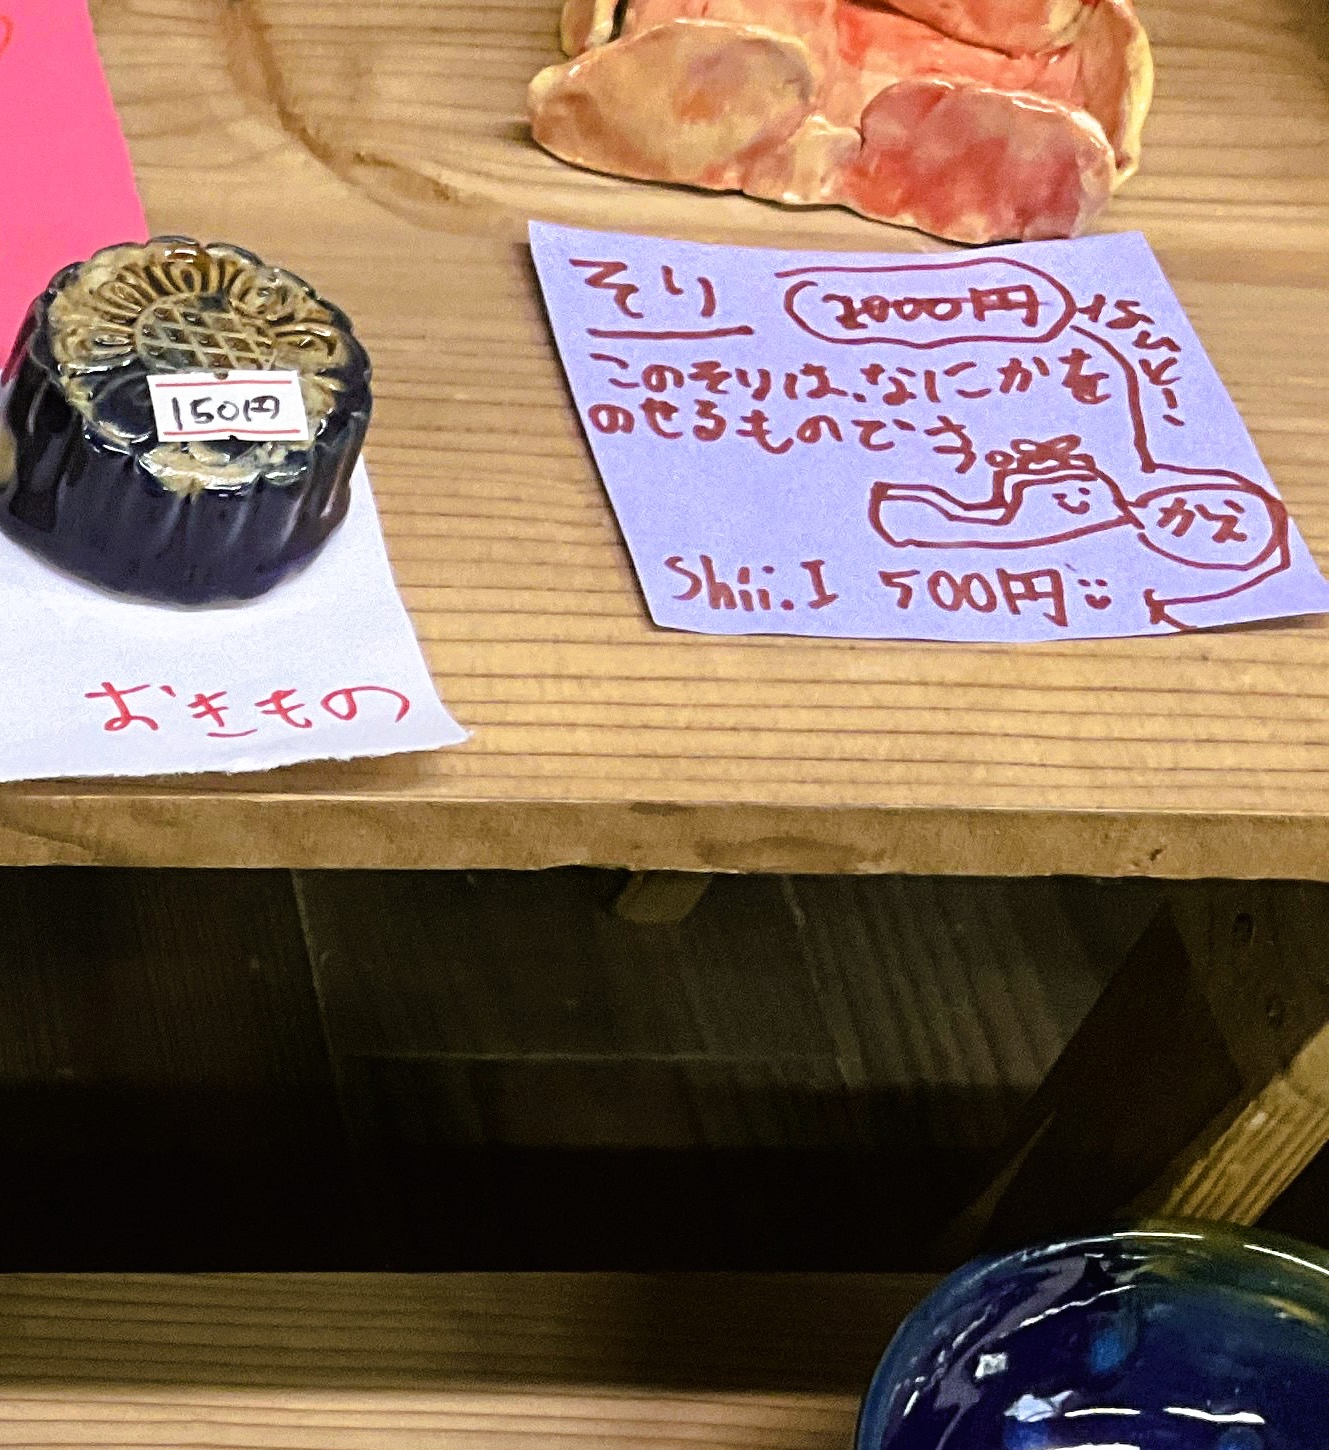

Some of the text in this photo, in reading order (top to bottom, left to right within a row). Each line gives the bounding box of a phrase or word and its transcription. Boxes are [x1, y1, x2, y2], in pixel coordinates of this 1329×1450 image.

[570, 257, 715, 318] そり
[171, 396, 281, 430] 150円
[881, 565, 1070, 627] 500円
[85, 681, 409, 738] おきもの
